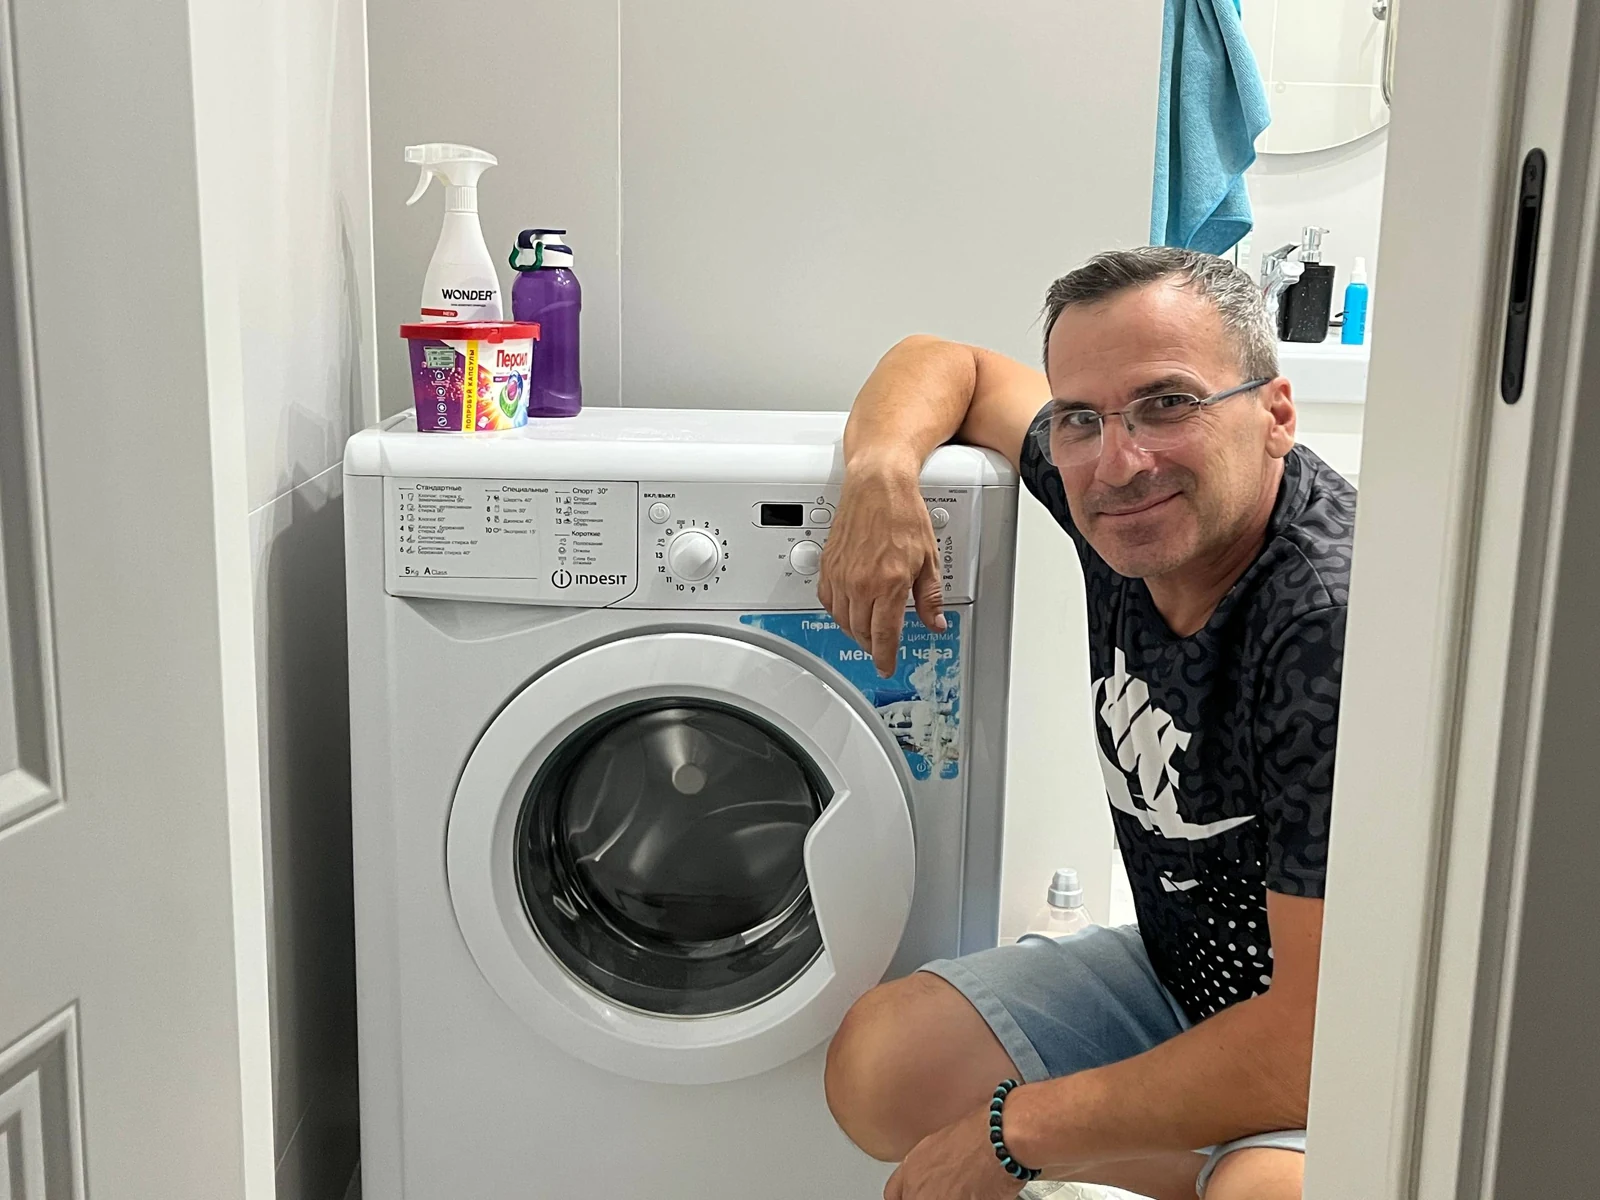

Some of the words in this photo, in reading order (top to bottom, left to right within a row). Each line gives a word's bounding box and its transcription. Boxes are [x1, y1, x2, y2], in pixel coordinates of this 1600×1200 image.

[442, 288, 492, 300] WONDER
[496, 350, 528, 370] Персил
[908, 633, 954, 643] циклами
[900, 646, 906, 660] 1
